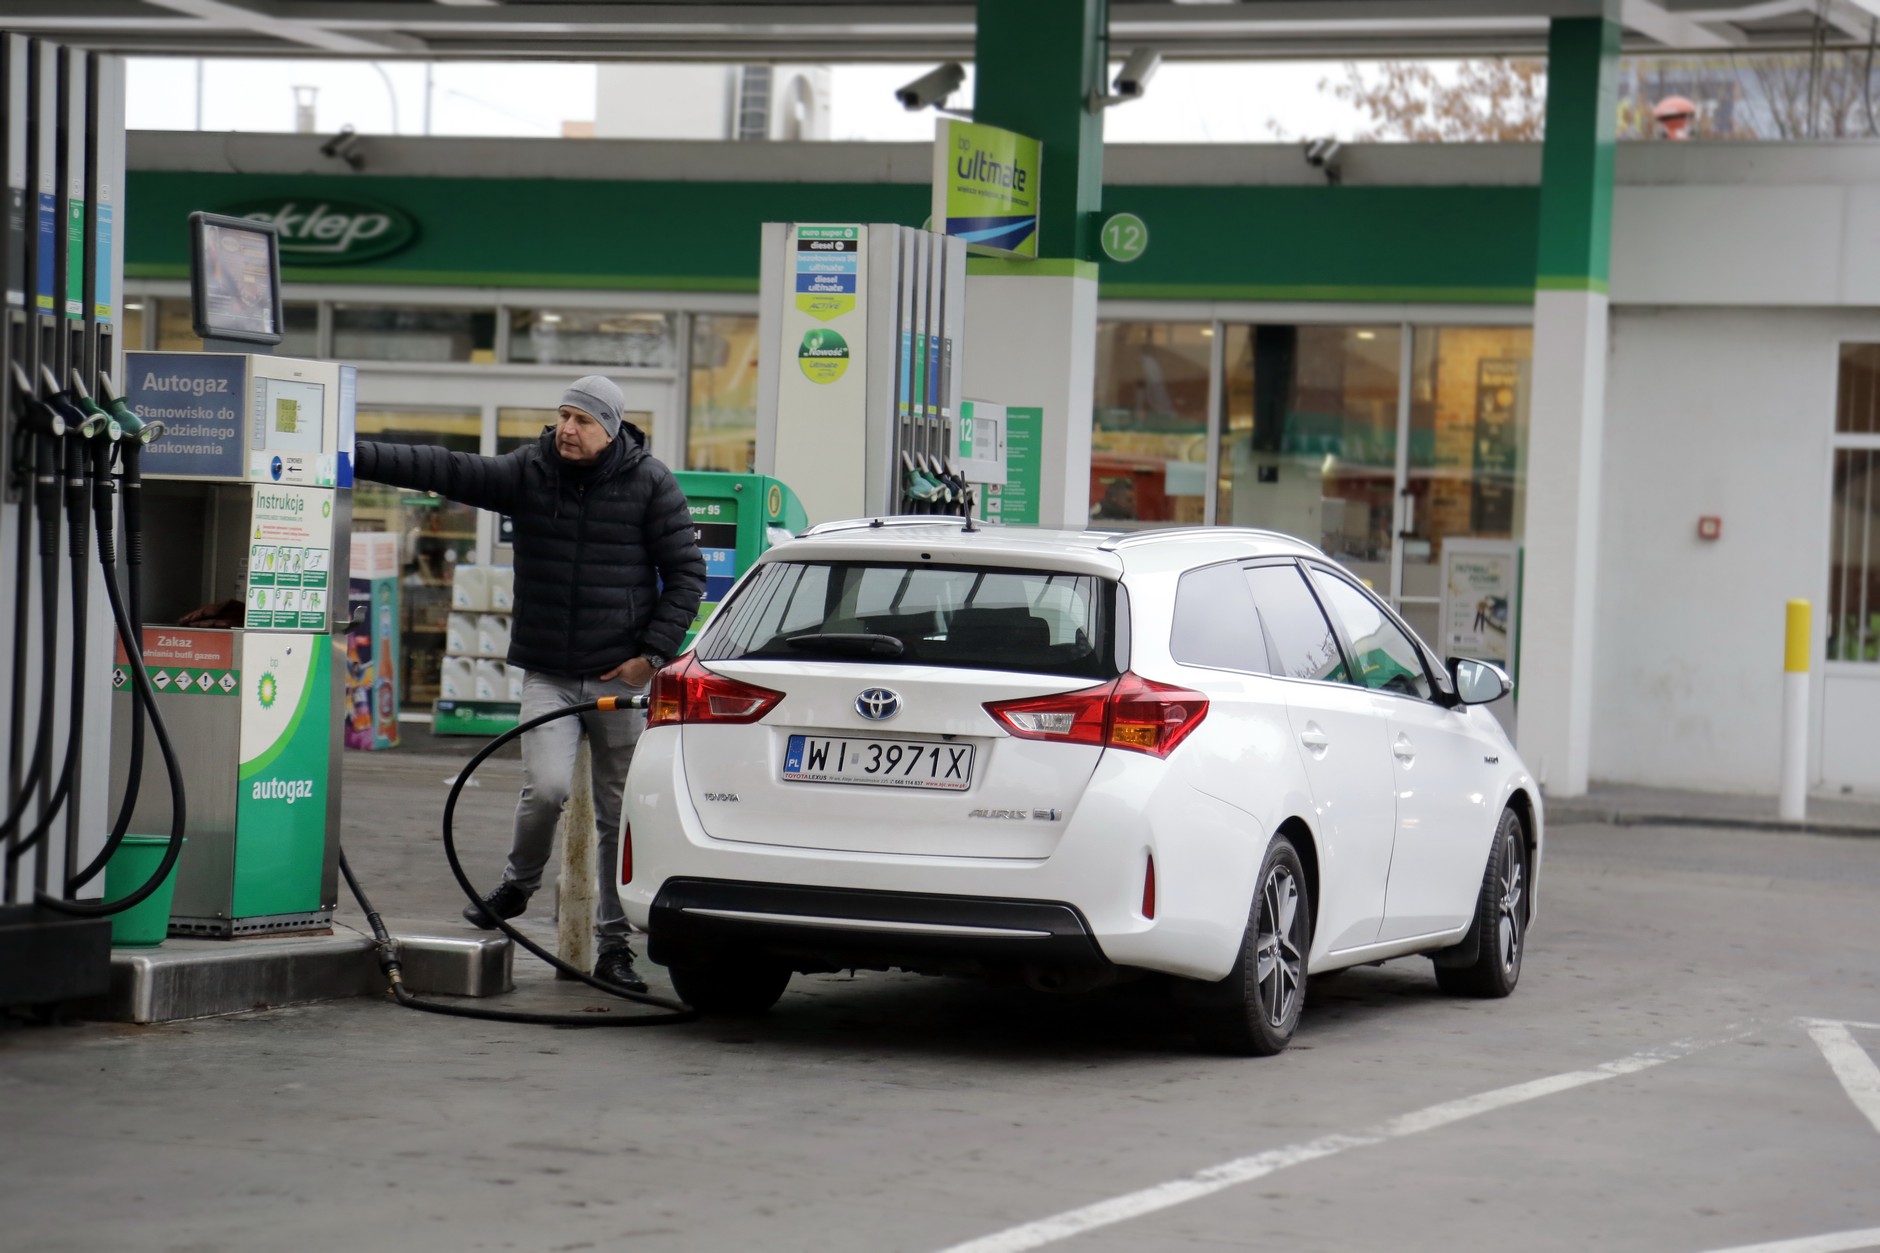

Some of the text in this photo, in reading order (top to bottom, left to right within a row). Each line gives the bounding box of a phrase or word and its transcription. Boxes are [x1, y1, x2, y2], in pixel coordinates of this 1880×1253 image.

[958, 135, 970, 152] bp
[957, 150, 1026, 192] ultimate
[821, 230, 843, 238] super
[1109, 225, 1140, 250] 12
[810, 241, 834, 250] diesel
[809, 264, 844, 272] ultimate
[814, 275, 838, 283] diesel
[808, 284, 844, 292] ultimate
[142, 372, 228, 396] Autogaz
[135, 404, 235, 420] Stanowisko do
[961, 418, 973, 442] 12
[145, 441, 223, 455] tankowania
[256, 490, 304, 515] Instrukcja
[707, 505, 721, 515] 95
[712, 552, 726, 561] 98
[157, 635, 192, 648] Zakaz
[174, 651, 193, 659] butli
[194, 653, 220, 661] gazem
[270, 657, 278, 669] bp
[788, 759, 800, 768] PL
[807, 740, 966, 779] WI 3971X
[252, 777, 313, 804] autogaz
[705, 793, 740, 801] TOYOTA
[968, 809, 1027, 820] AURIS
